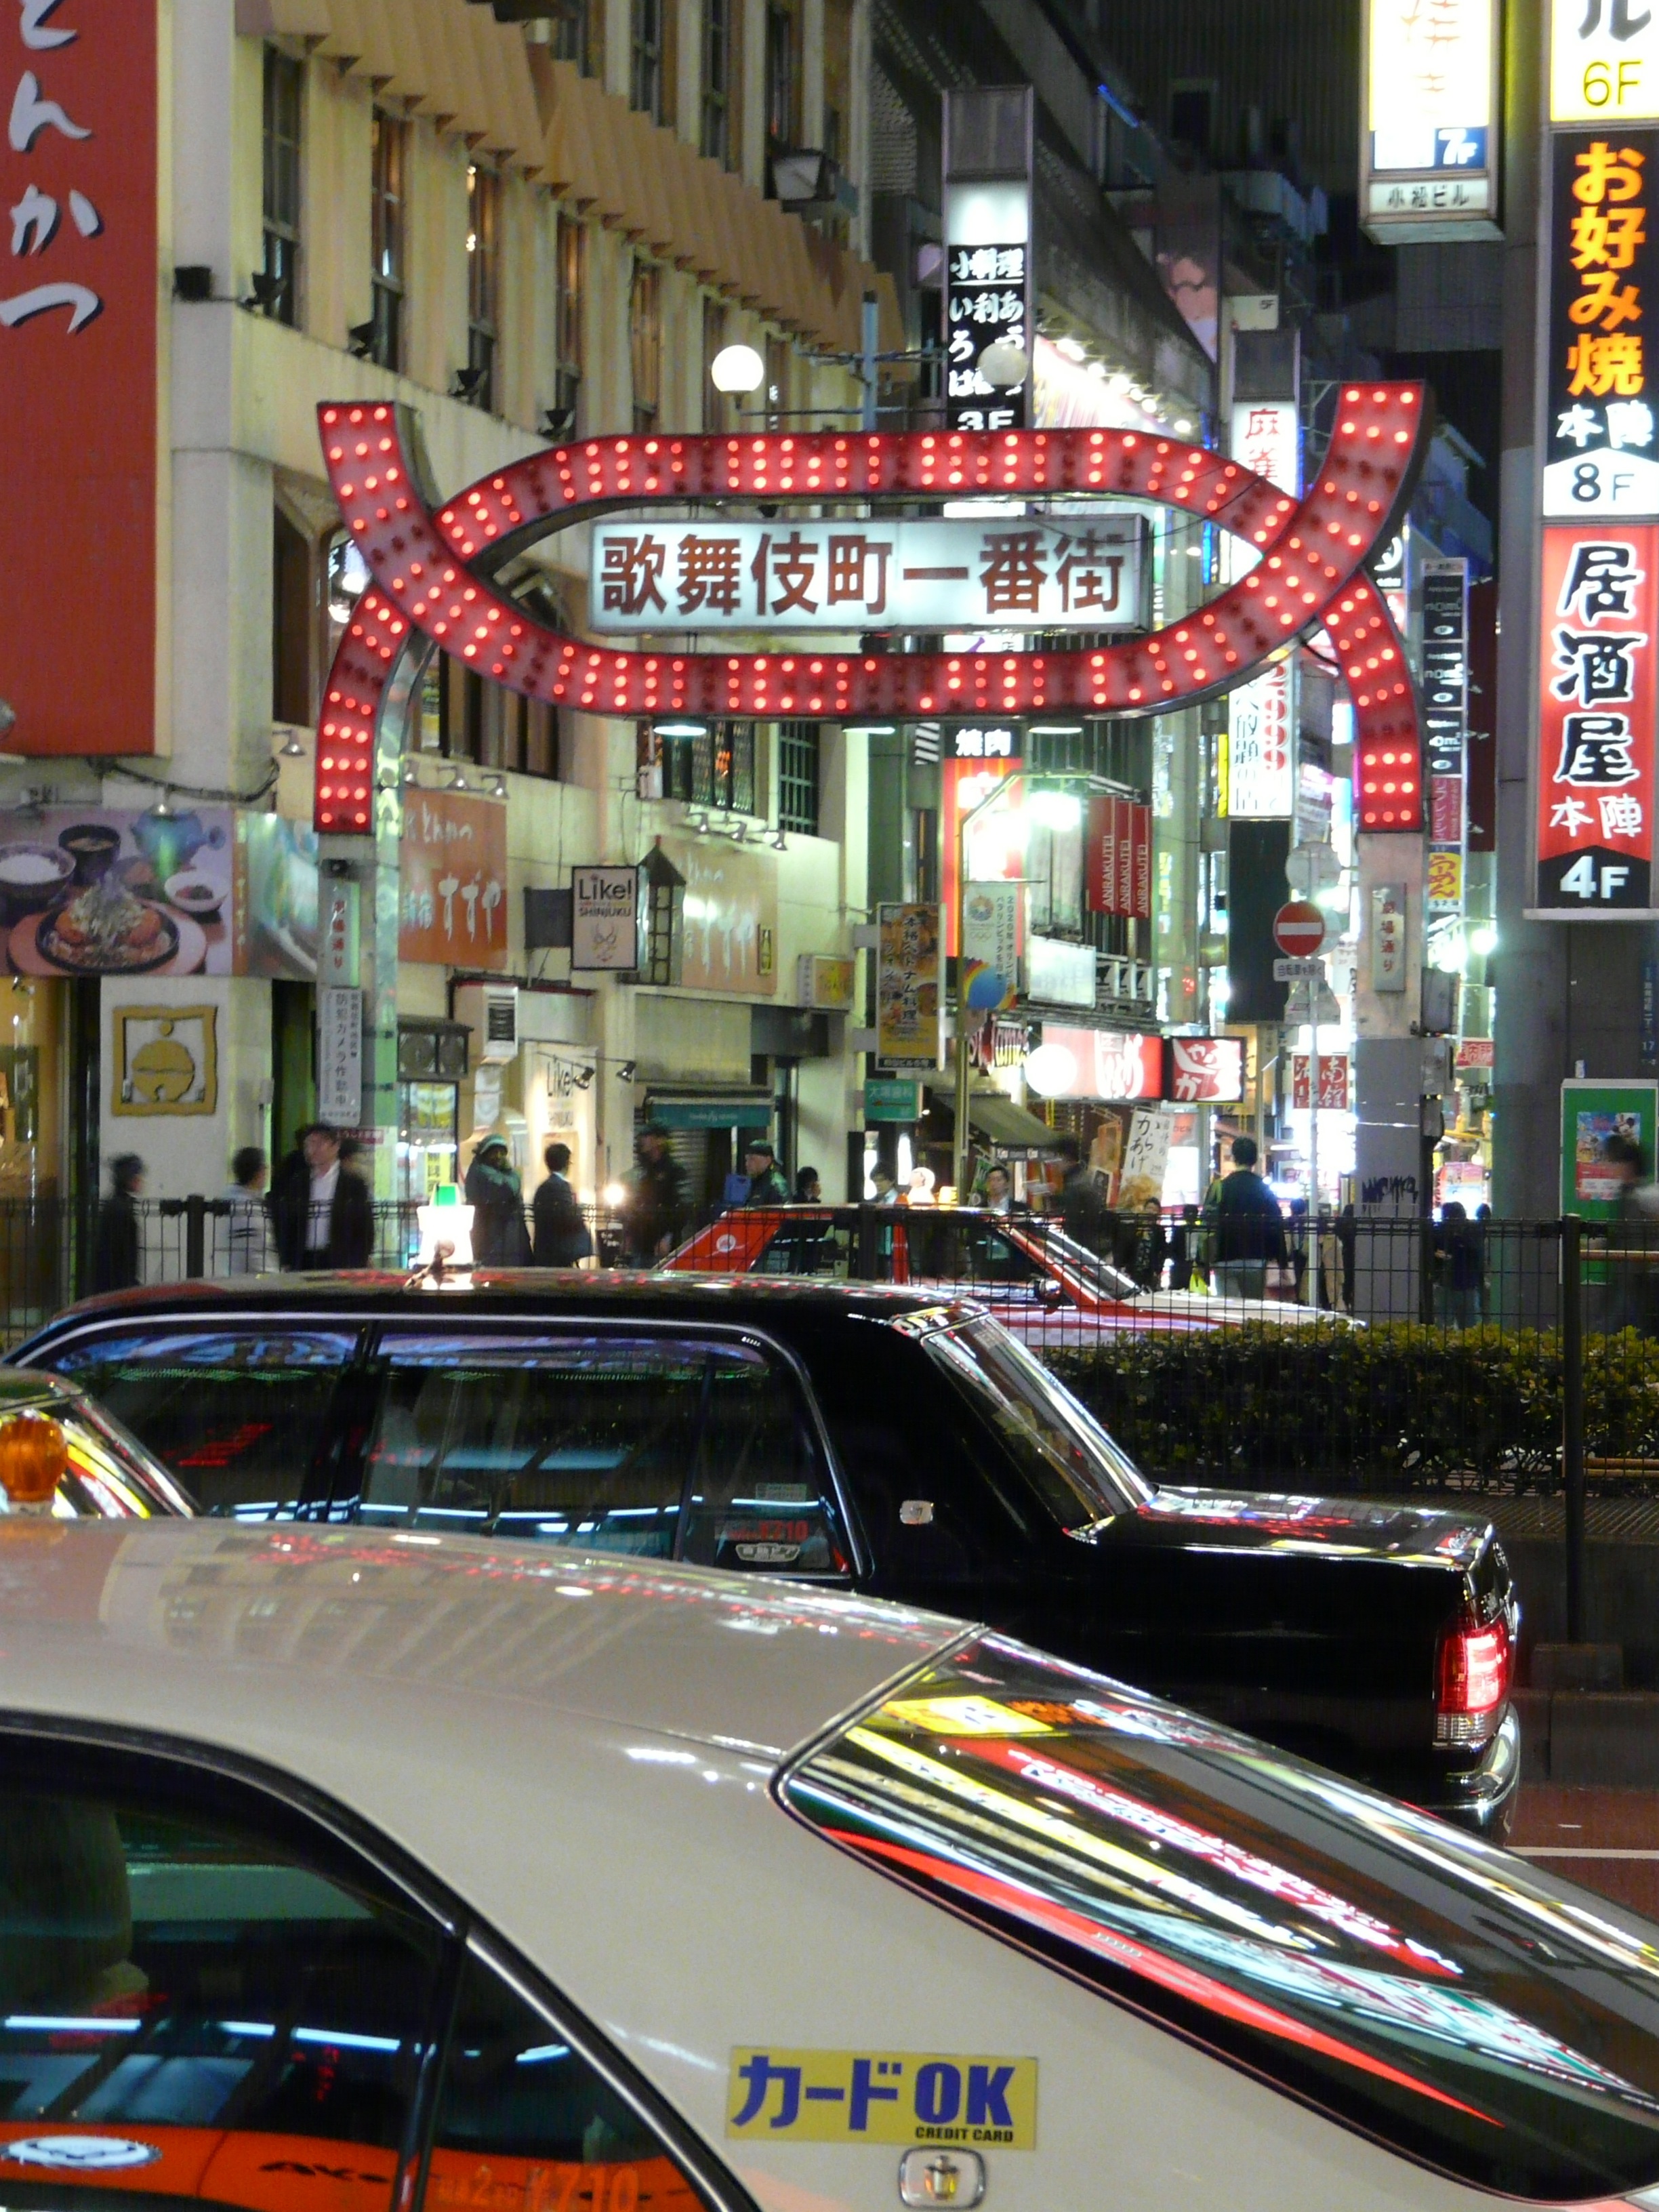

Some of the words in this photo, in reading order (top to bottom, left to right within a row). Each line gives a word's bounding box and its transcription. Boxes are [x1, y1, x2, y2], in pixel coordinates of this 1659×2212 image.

[1583, 60, 1643, 106] 6F
[0, 0, 103, 335] とんかつ
[1437, 128, 1478, 165] 7F
[1565, 141, 1647, 397] お好み焼
[957, 410, 1015, 431] 3F
[1245, 408, 1280, 478] 麻雀
[1556, 399, 1654, 450] 本陣
[1572, 461, 1635, 502] 8F
[600, 529, 1124, 617] 歌舞伎町一番街
[1550, 540, 1647, 790] 居酒屋
[956, 729, 1011, 756] 焼肉
[1549, 794, 1645, 840] 本陣
[579, 874, 632, 900] Like!
[1102, 836, 1113, 909] ANRAKUTEI
[1120, 840, 1130, 913] ANRAKUTEI
[1136, 844, 1147, 916] ANRAKUTEI
[1559, 855, 1630, 901] 4F
[579, 907, 632, 917] SHINJUKU
[903, 916, 918, 1020] 本格ベトナム料理
[1277, 964, 1322, 977] 自転車を除く
[915, 2126, 968, 2141] CREDIT
[972, 2127, 1014, 2143] CARD
